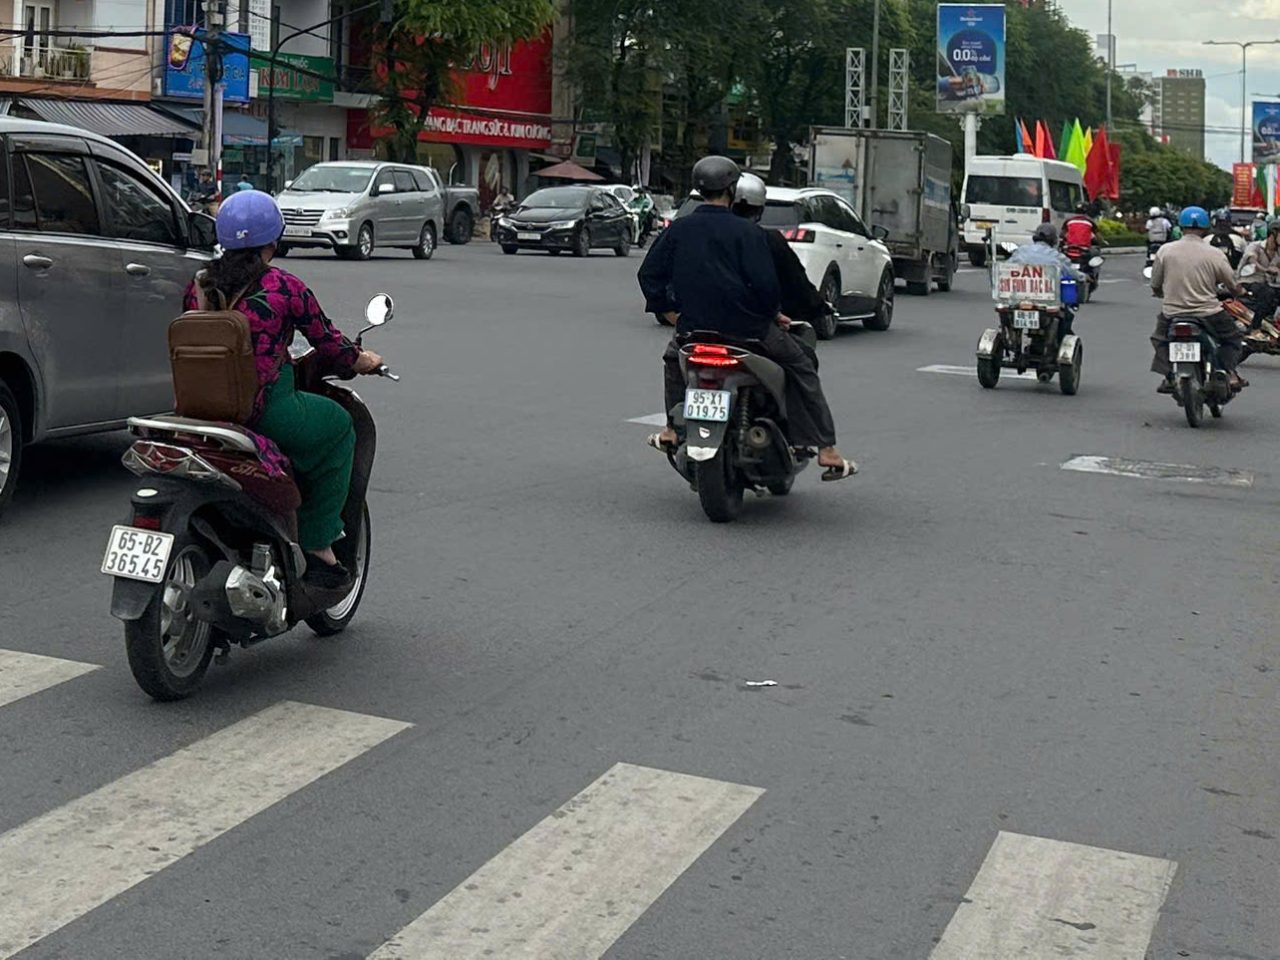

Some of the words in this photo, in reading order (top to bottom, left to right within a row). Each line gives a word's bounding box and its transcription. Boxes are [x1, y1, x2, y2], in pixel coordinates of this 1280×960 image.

[1179, 69, 1203, 78] SHB
[462, 119, 488, 135] TRANG
[693, 391, 722, 405] 95-X1
[688, 405, 726, 419] 019.75
[118, 531, 163, 556] 65-B2
[107, 551, 164, 579] 365.45
